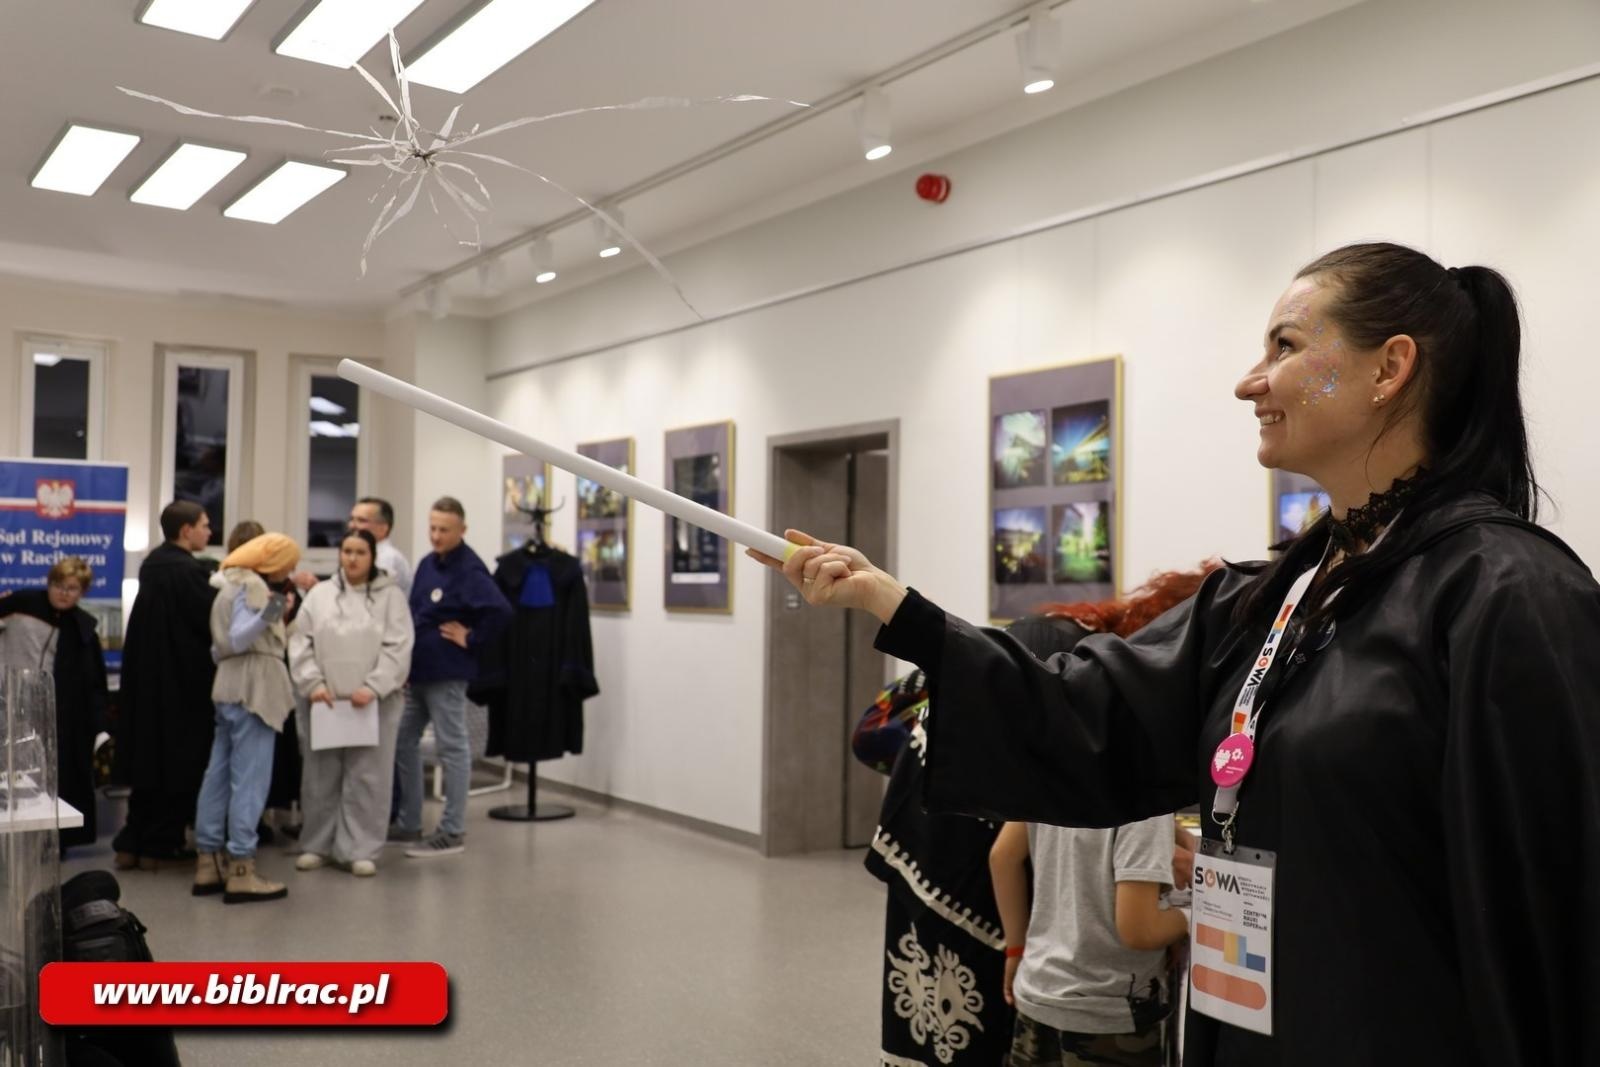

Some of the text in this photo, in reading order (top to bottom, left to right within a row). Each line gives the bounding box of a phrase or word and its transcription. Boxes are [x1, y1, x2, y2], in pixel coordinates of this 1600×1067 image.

[32, 529, 113, 549] Rejonowy
[1, 549, 106, 565] w Racirzu
[1247, 647, 1273, 687] SOWA
[1195, 866, 1240, 895] SOWA
